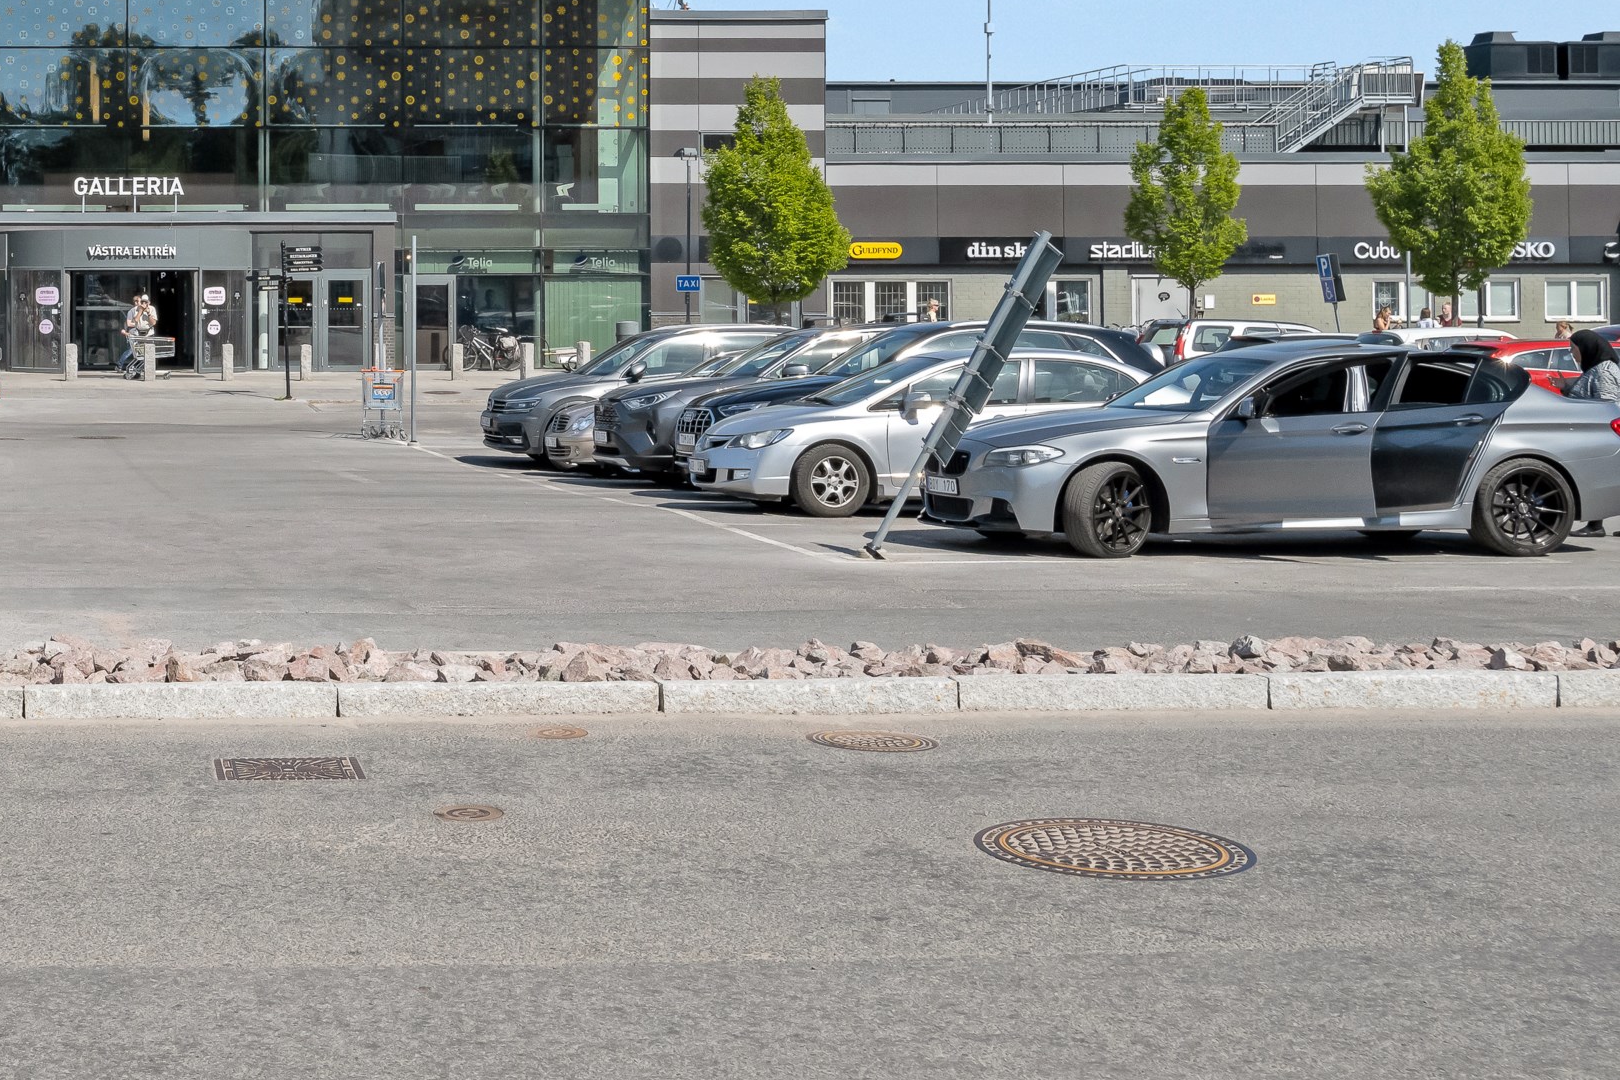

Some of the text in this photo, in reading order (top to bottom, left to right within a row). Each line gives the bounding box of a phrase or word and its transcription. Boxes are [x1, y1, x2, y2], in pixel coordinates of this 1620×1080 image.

[73, 177, 184, 196] GALLERIA
[88, 244, 177, 256] VÄSTRA ENTRÉN
[967, 241, 1028, 258] din sk
[1090, 241, 1155, 258] stadiu
[1354, 240, 1401, 259] Cubu
[1509, 241, 1555, 258] SKO
[467, 257, 493, 267] Telia
[589, 257, 616, 267] Telia
[677, 279, 699, 288] TAXI
